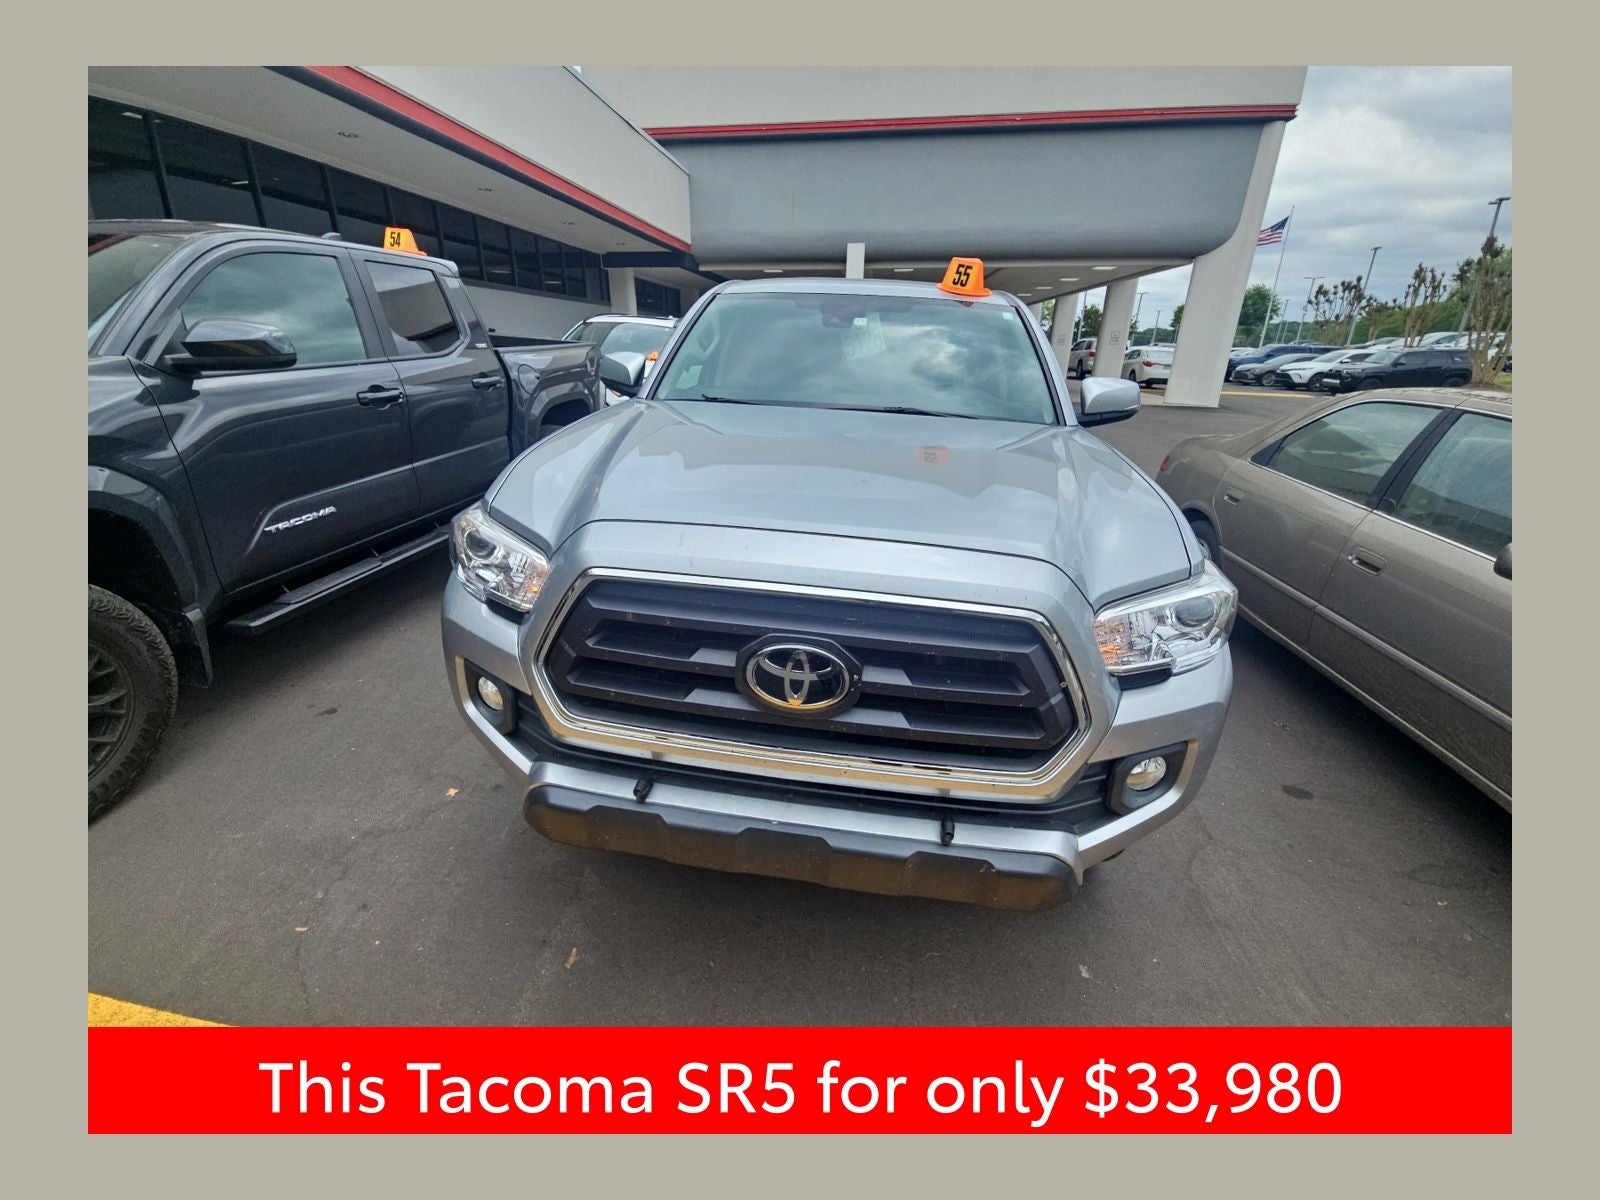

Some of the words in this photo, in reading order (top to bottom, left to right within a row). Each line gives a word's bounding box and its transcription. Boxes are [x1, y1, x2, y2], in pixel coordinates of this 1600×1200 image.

[389, 231, 401, 248] 54
[951, 263, 974, 288] 55
[263, 505, 338, 534] TACOMA
